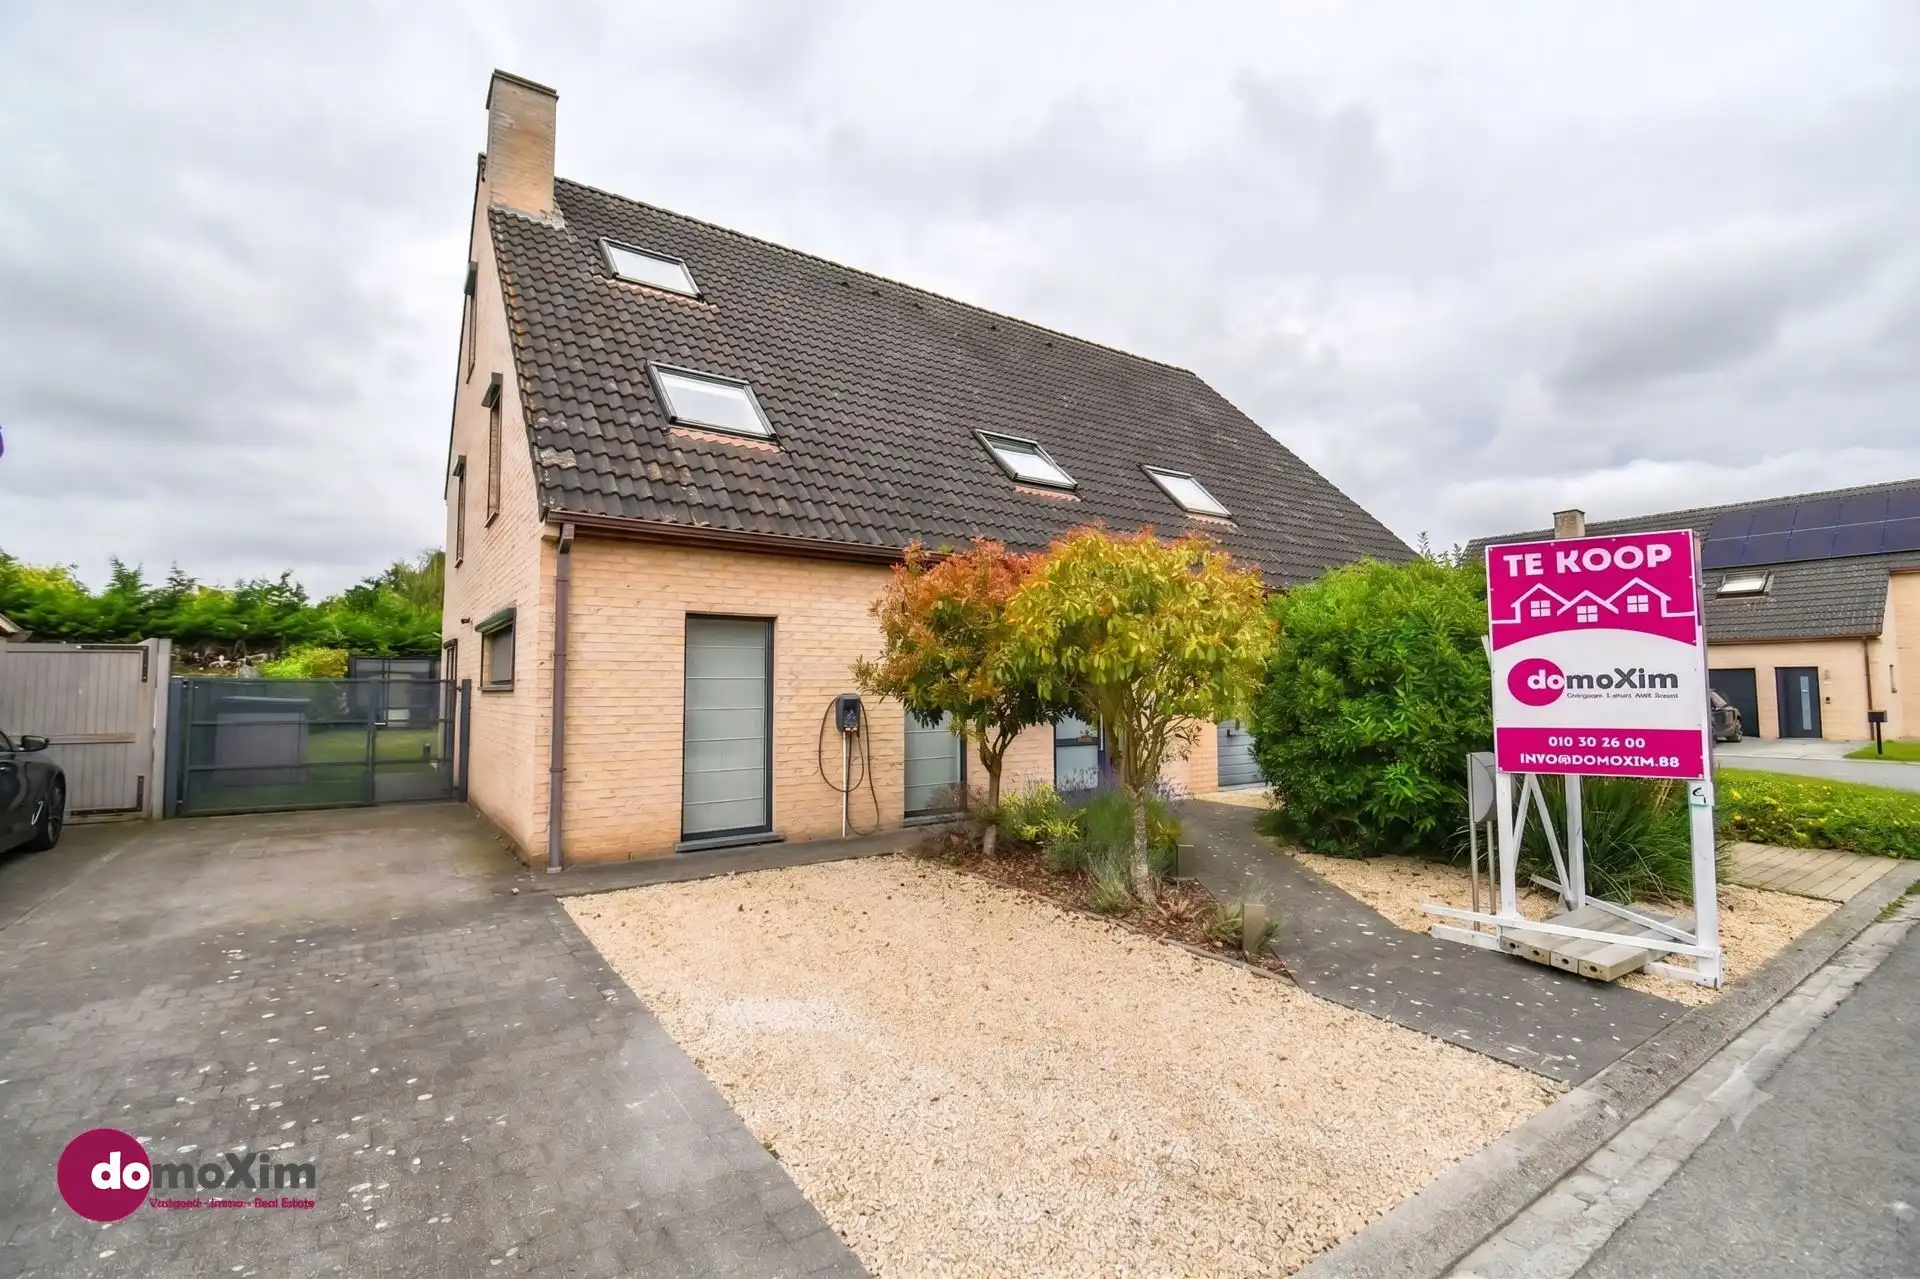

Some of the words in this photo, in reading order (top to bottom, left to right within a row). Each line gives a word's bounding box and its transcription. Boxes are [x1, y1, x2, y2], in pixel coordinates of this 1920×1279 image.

[1503, 552, 1544, 577] TE
[1556, 544, 1672, 573] KOOP
[1527, 668, 1678, 690] domoXim
[1548, 736, 1573, 747] 010
[1578, 737, 1597, 747] 30
[1601, 737, 1620, 748] 26
[1624, 738, 1646, 748] 00
